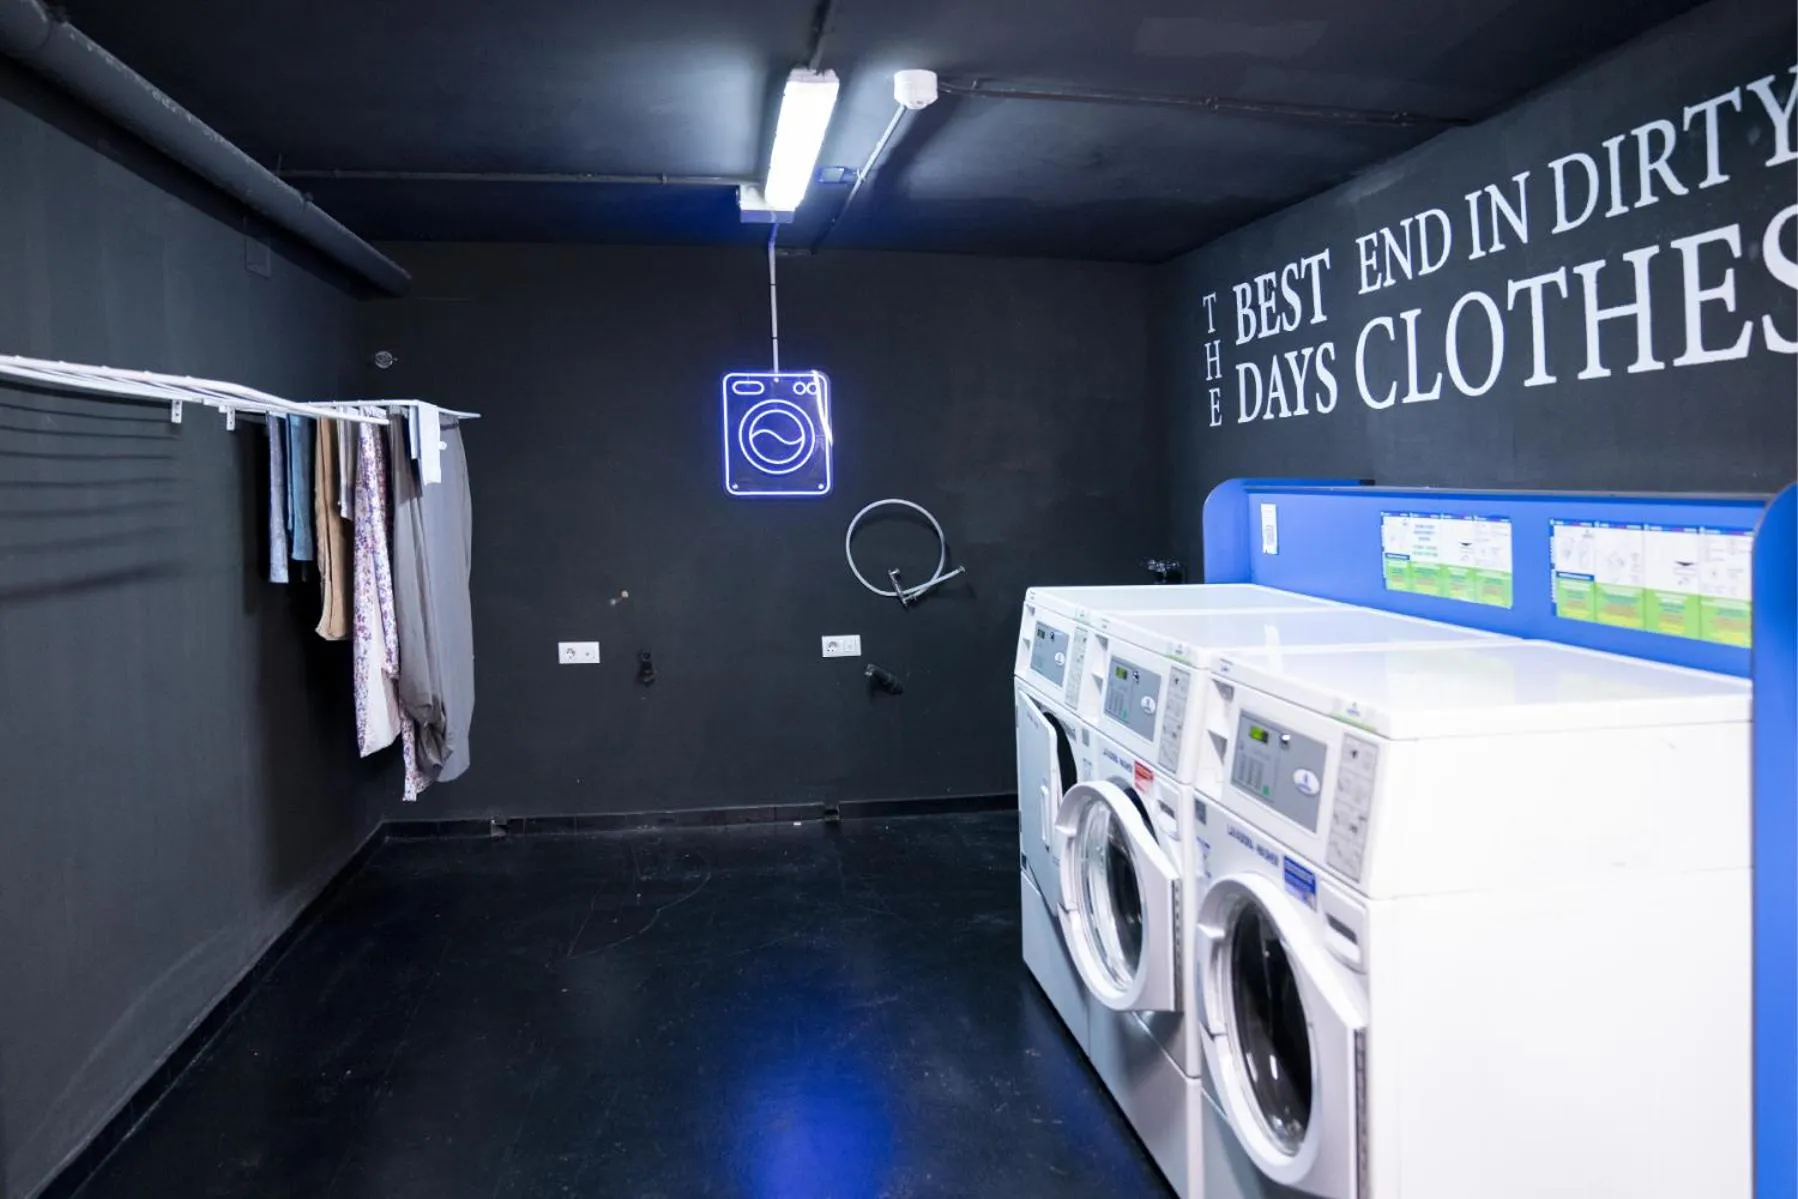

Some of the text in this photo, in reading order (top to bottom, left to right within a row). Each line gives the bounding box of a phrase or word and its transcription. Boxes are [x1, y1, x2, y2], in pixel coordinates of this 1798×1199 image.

[1232, 64, 1798, 346] BEST END IN DIRTY
[1202, 292, 1223, 427] THE
[1235, 341, 1339, 424] DAYS
